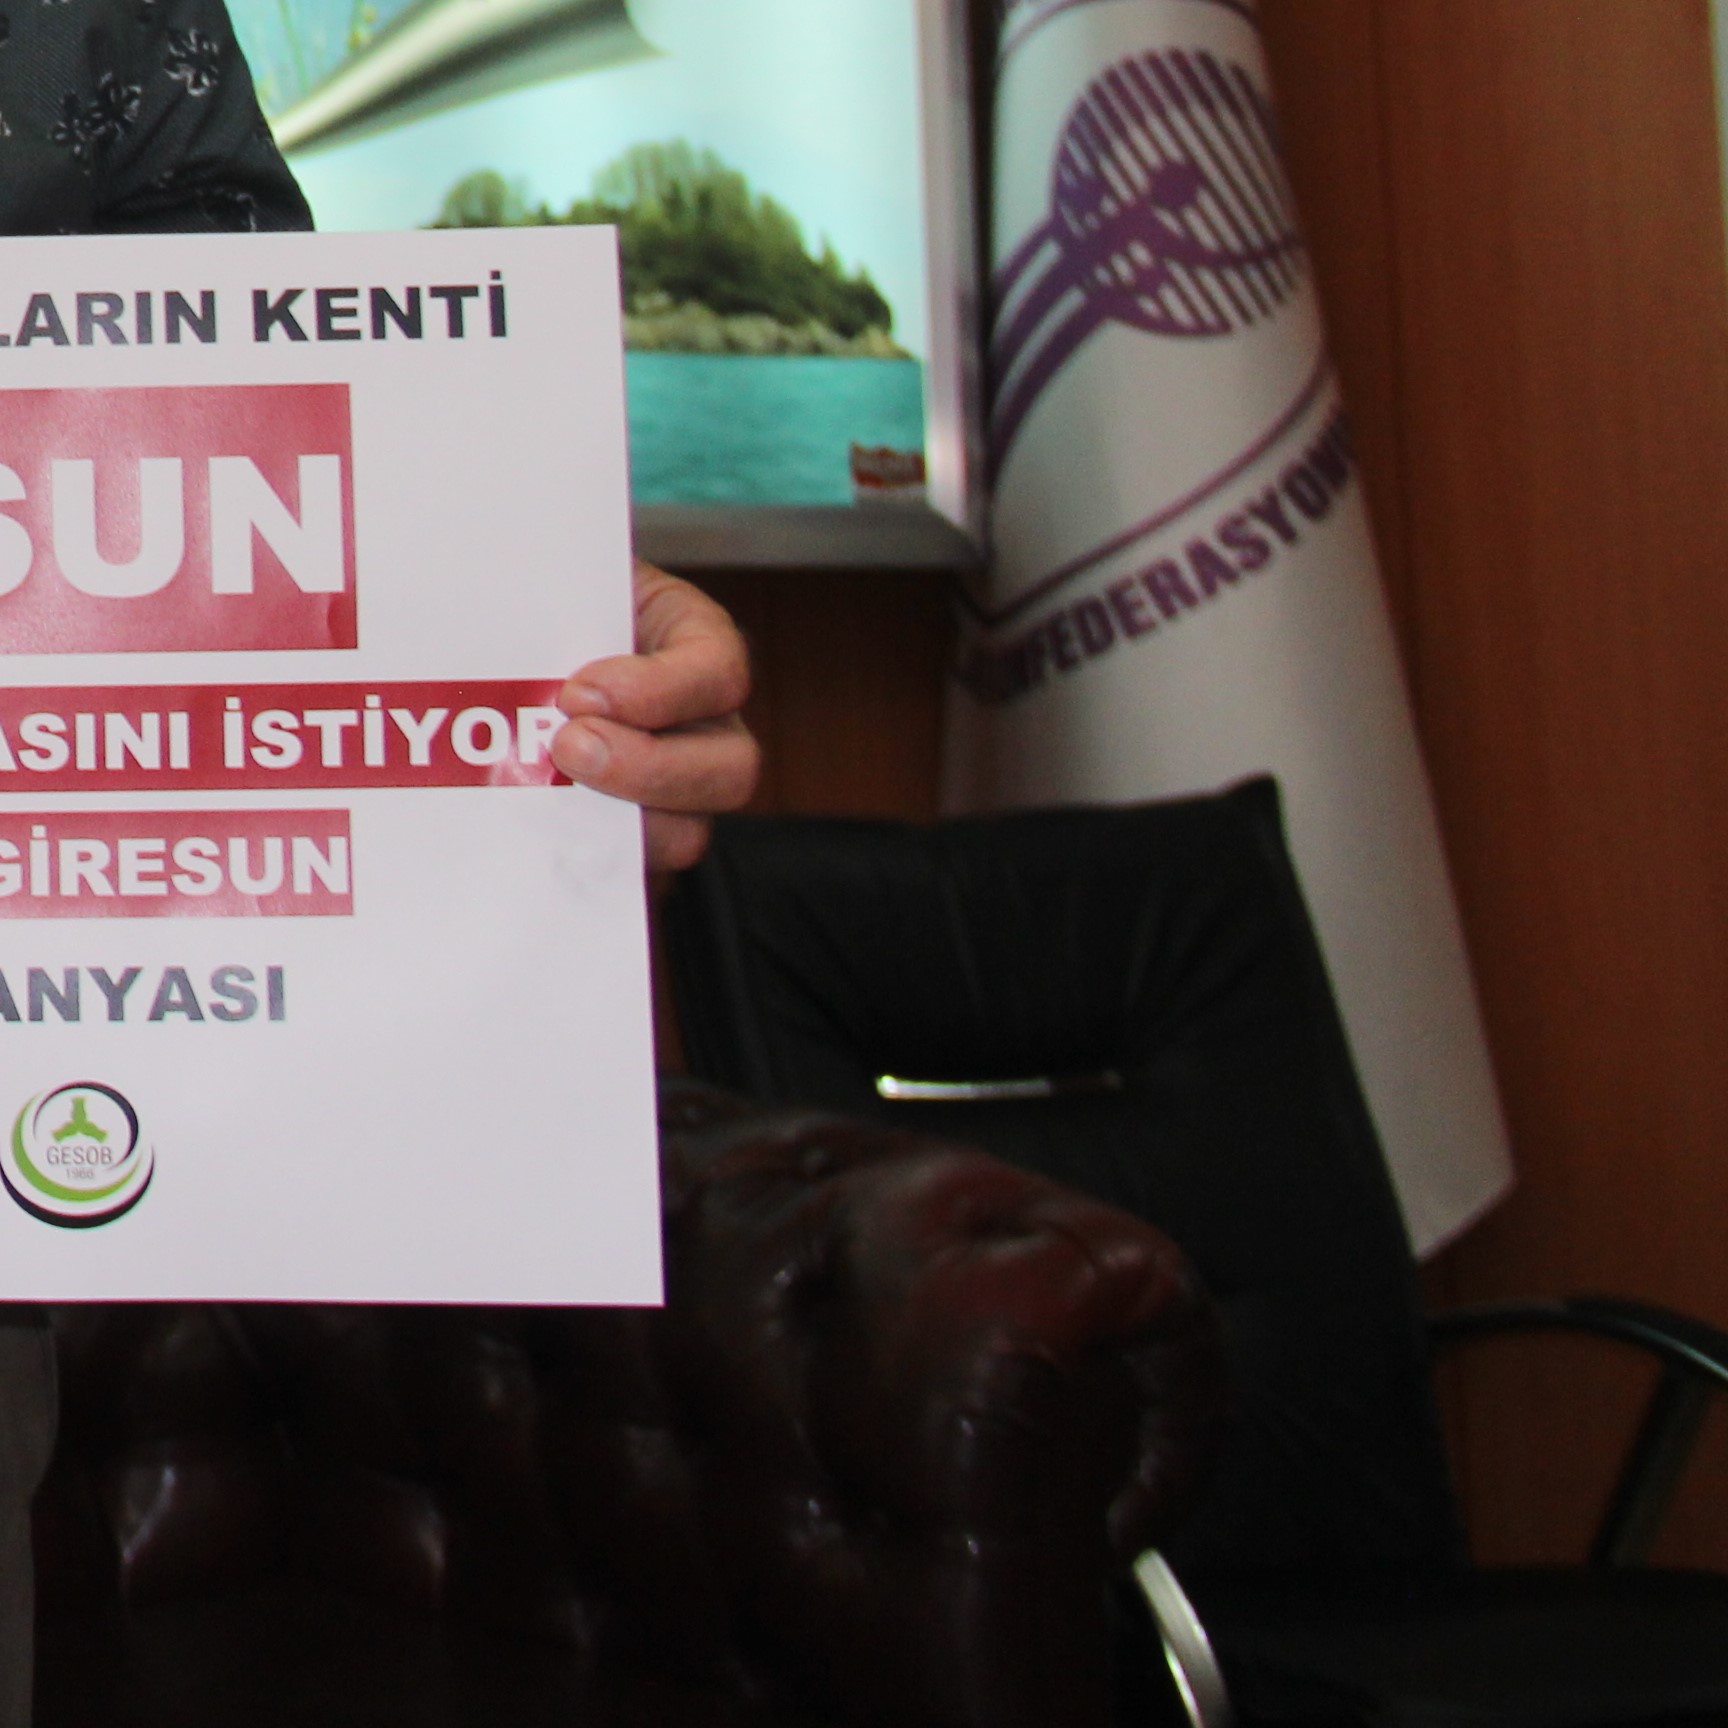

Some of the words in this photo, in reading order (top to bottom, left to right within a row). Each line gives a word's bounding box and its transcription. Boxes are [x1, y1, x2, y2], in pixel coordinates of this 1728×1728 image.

[252, 269, 509, 343] KENTİ
[223, 695, 569, 768] İSTİYOR
[46, 1145, 113, 1166] GESOB
